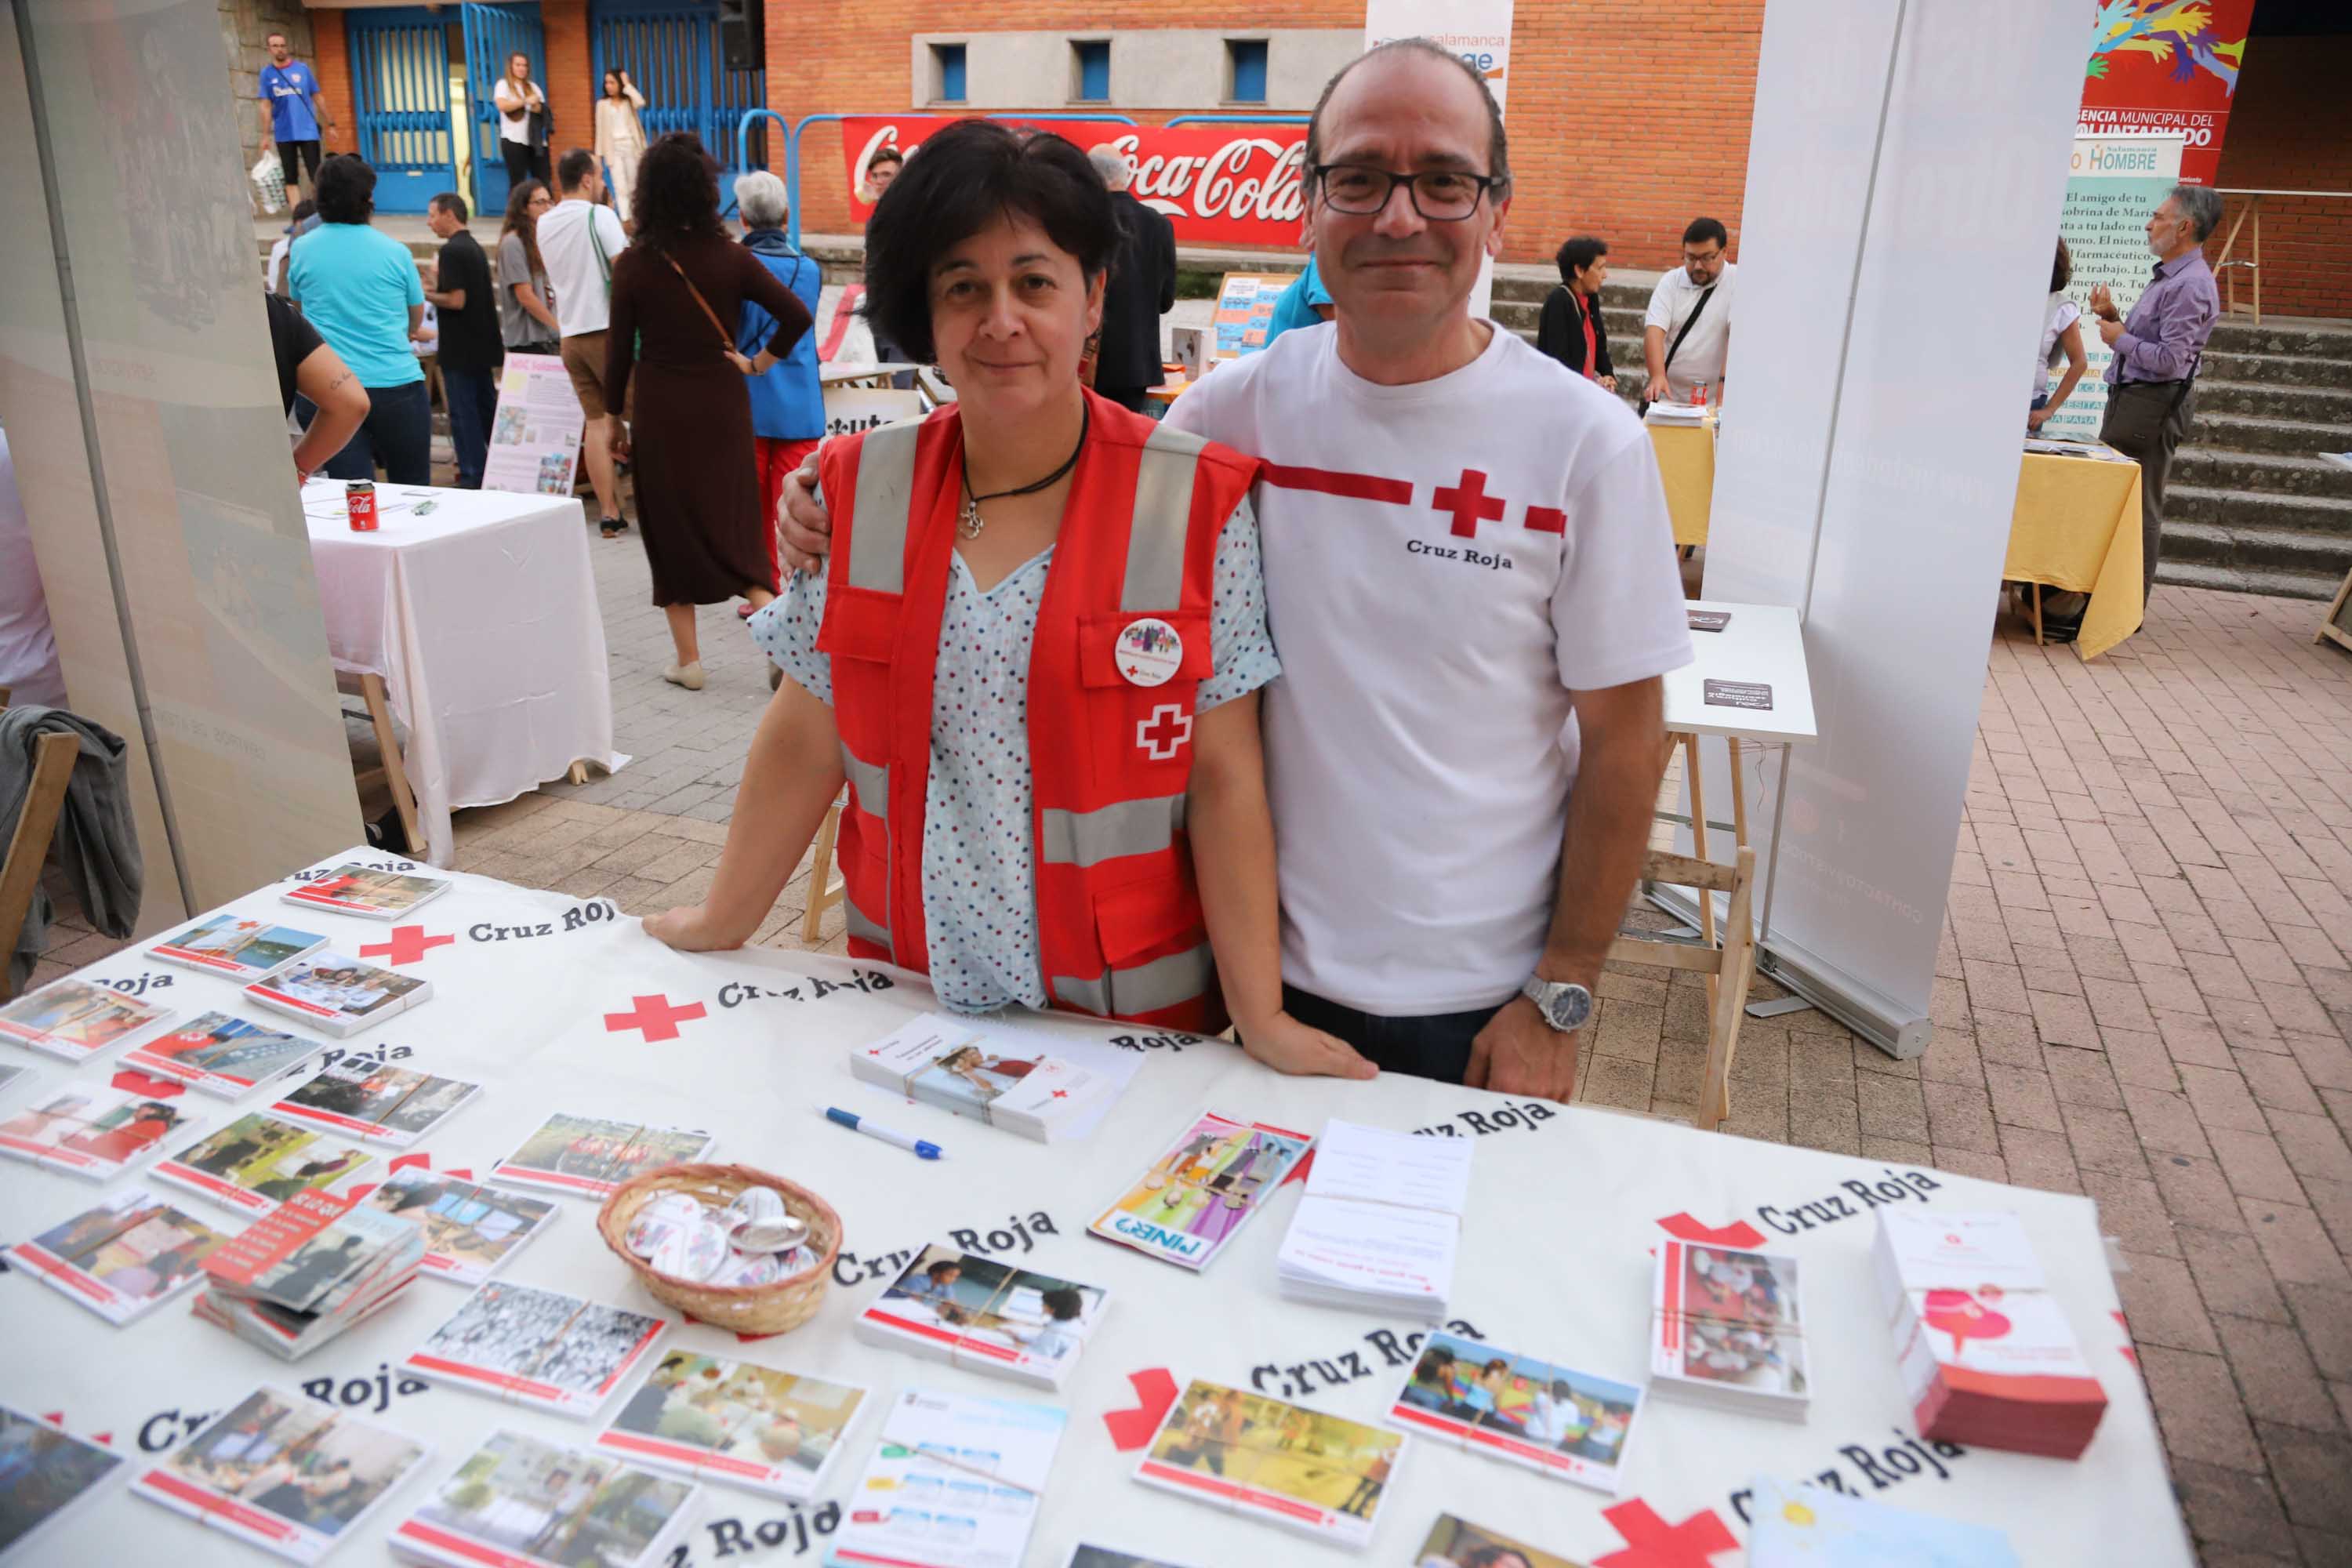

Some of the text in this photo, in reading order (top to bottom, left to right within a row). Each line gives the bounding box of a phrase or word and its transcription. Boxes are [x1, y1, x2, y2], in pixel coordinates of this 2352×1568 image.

[2120, 112, 2187, 125] MUNICIPAL
[2190, 114, 2214, 126] DEL
[2080, 194, 2115, 205] amigo
[2118, 193, 2132, 202] de
[2135, 194, 2146, 203] tu
[2106, 207, 2120, 216] de
[2086, 222, 2097, 230] tu
[2100, 221, 2125, 231] lado
[2099, 235, 2111, 245] El
[2112, 236, 2140, 245] nieto
[2086, 263, 2130, 274] trabajo.
[2133, 266, 2147, 275] La
[1406, 539, 1513, 569] Cruz Roja
[470, 923, 553, 942] Cruz
[1457, 1098, 1557, 1136] Roja
[1758, 1167, 1942, 1236] Cruz Roja
[949, 1210, 1058, 1254] Roja
[706, 1500, 841, 1559] Roja
